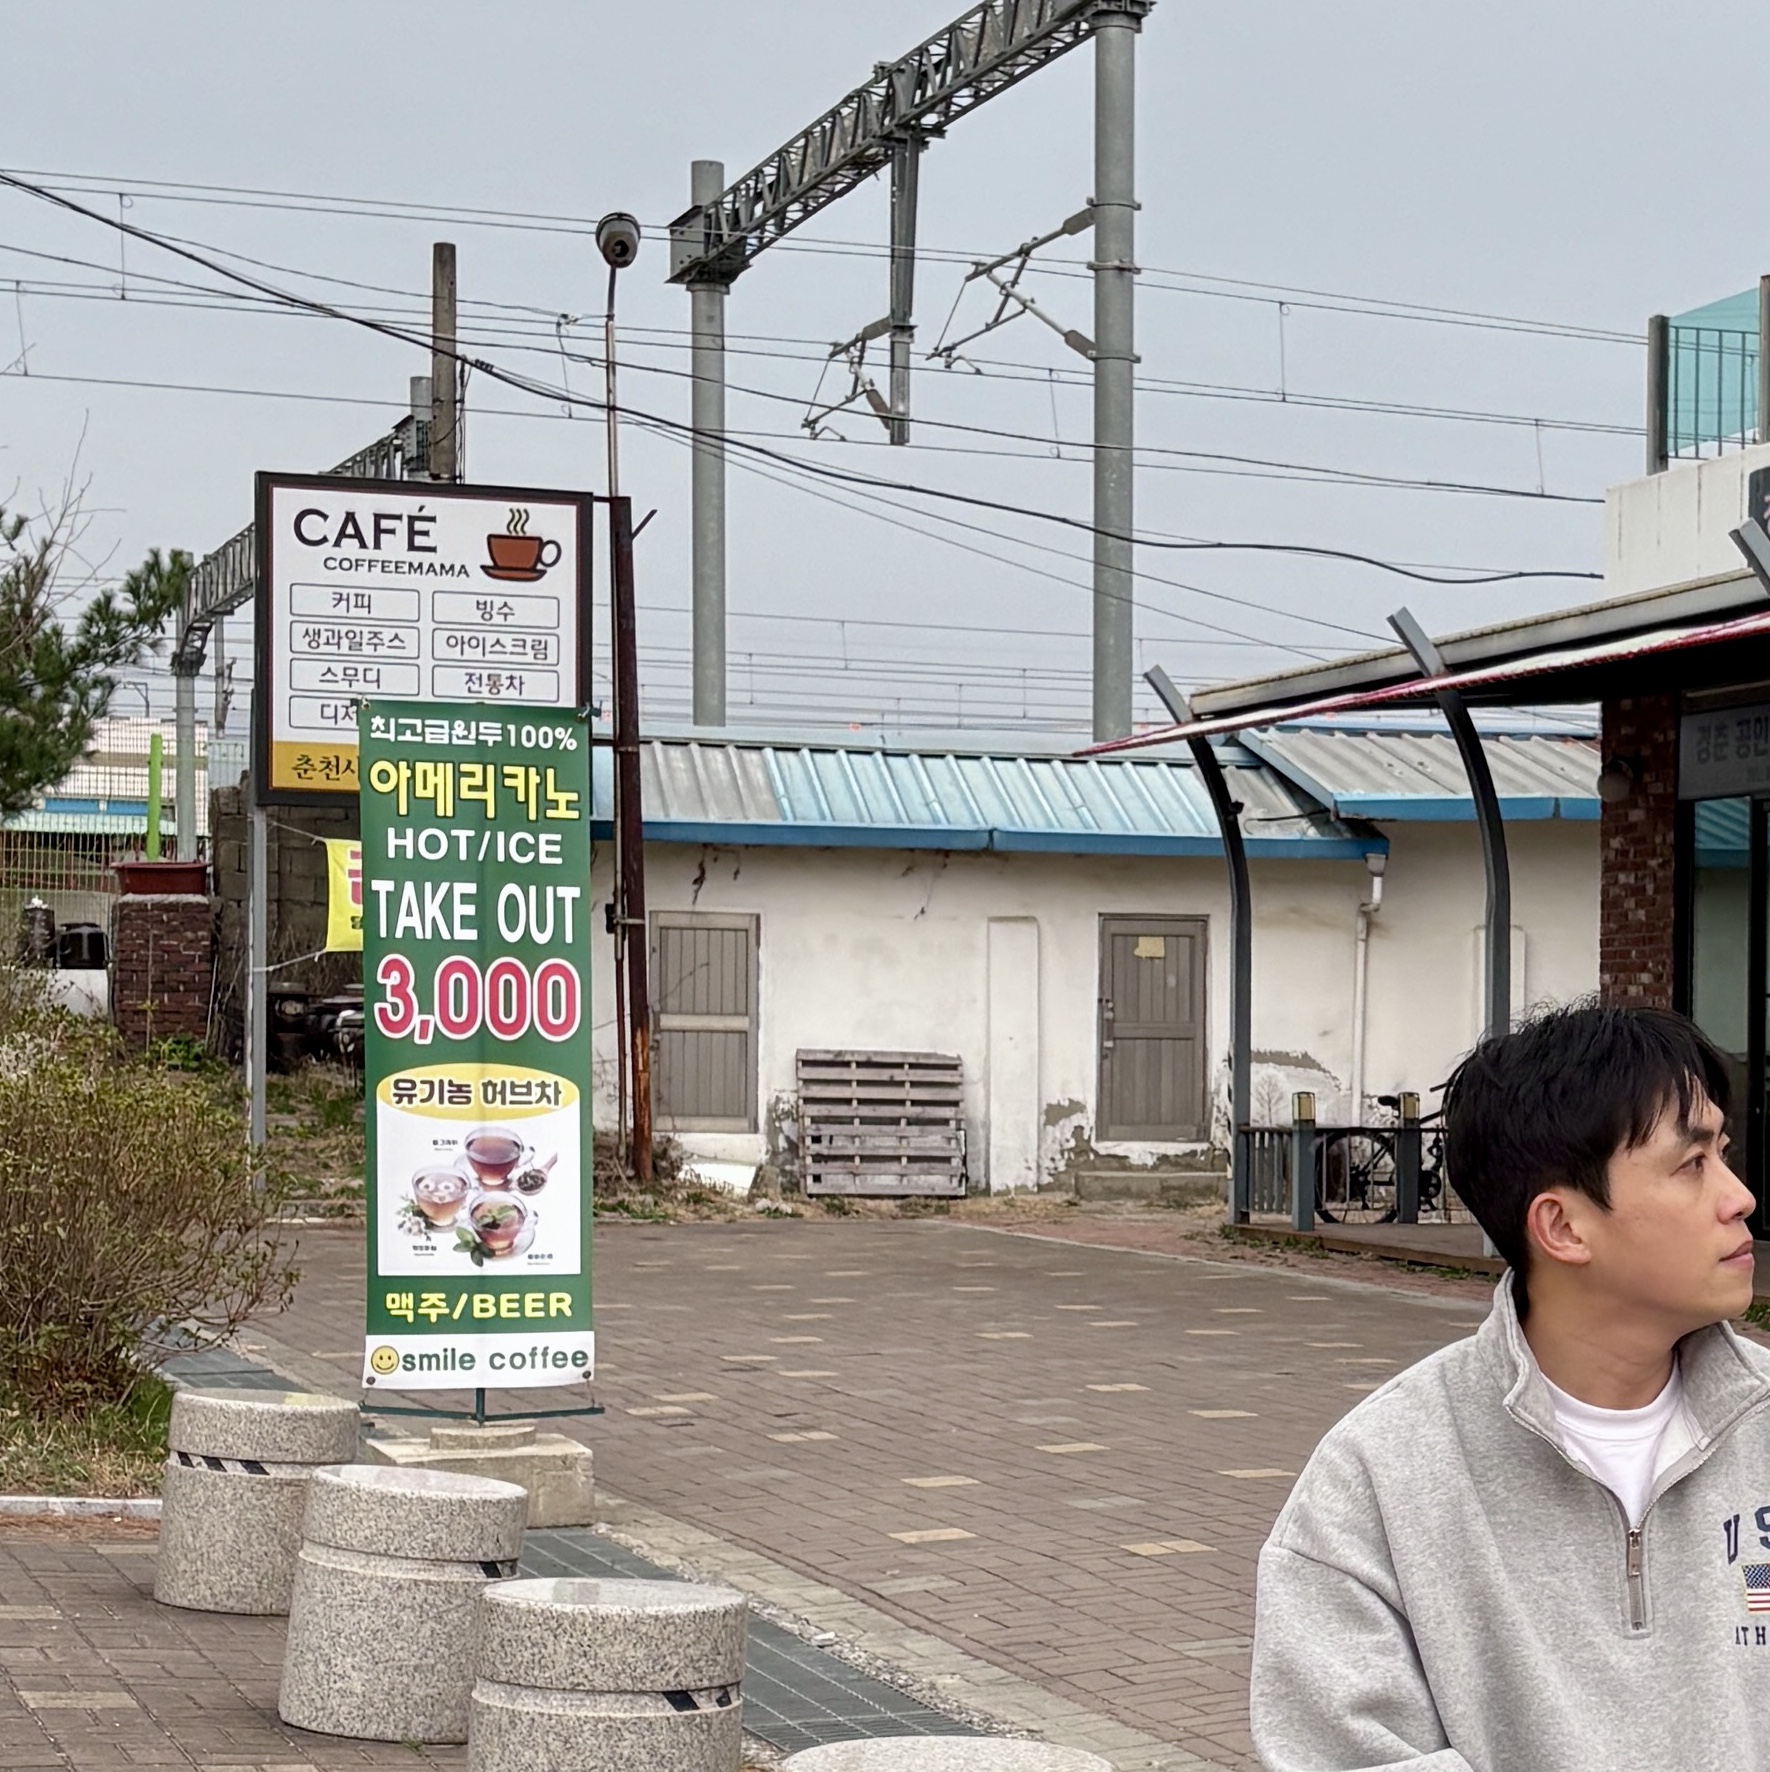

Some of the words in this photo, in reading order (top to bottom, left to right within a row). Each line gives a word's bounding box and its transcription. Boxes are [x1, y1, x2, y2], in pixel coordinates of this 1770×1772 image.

[293, 506, 438, 554] CAFÉ
[323, 555, 470, 578] COFFEEMAMA
[330, 590, 373, 616] 커피
[475, 598, 516, 623] 빙수
[301, 627, 408, 652] 생과일주스
[445, 634, 549, 661] 아이스크림
[318, 665, 382, 690] 스무디
[464, 672, 526, 697] 전통차
[320, 703, 357, 726] 디저
[369, 759, 581, 821] 아메리카노
[387, 827, 563, 865] HOT/ICE
[371, 879, 478, 941] TAKE
[497, 882, 581, 944] OUT
[374, 953, 581, 1045] 3,000
[392, 1077, 473, 1106] 유기농
[481, 1079, 562, 1107] 허브차
[385, 1291, 573, 1324] 맥주/BEER
[402, 1349, 476, 1372] smile
[489, 1346, 589, 1370] coffee
